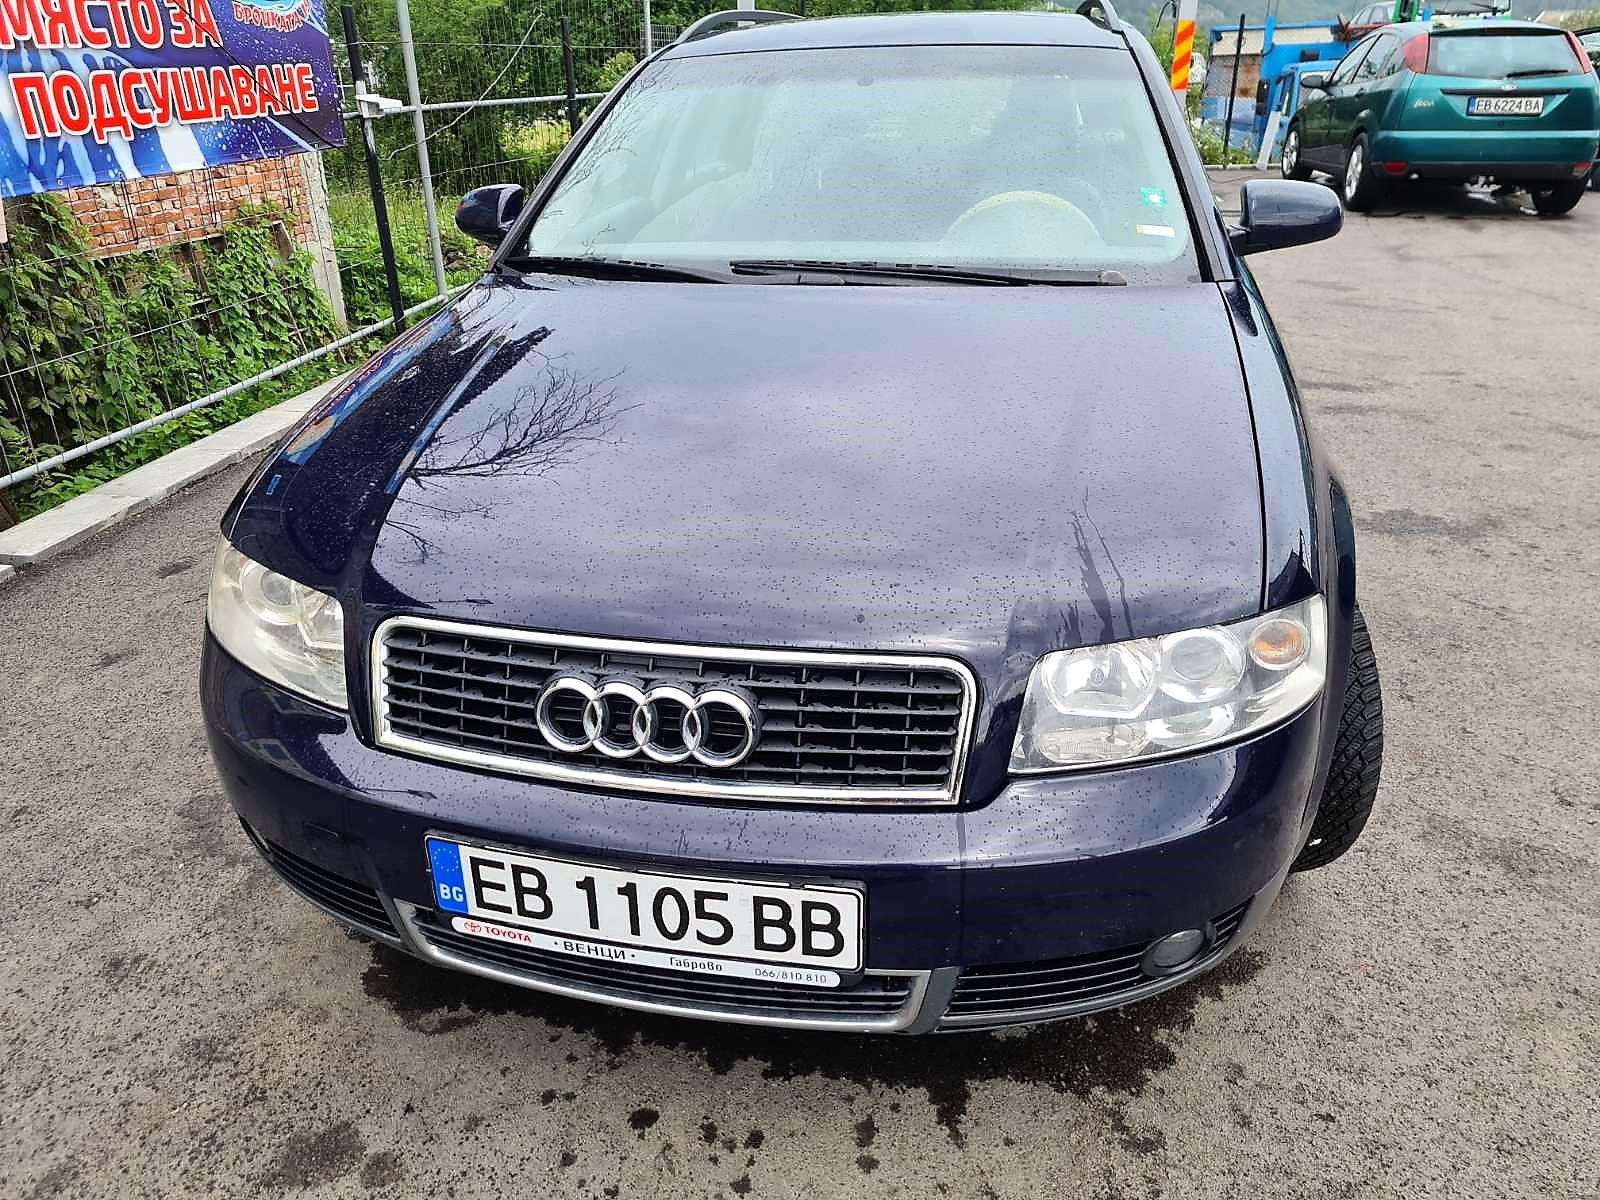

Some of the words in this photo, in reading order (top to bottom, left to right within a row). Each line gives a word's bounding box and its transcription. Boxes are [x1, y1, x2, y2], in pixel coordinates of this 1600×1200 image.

[0, 0, 163, 48] МЯСТО
[166, 0, 223, 47] ЗА
[10, 63, 319, 143] ПОДСУШАВАНЕ
[1494, 99, 1522, 112] 6224
[440, 883, 465, 903] BG
[468, 855, 553, 921] EB
[575, 875, 735, 946] 1105
[752, 895, 846, 958] BB
[485, 927, 533, 943] TOYOTA
[563, 941, 626, 960] ВЕНЦИ
[669, 957, 722, 971] Габрово
[755, 968, 801, 981] 066/810
[806, 973, 827, 983] 810
